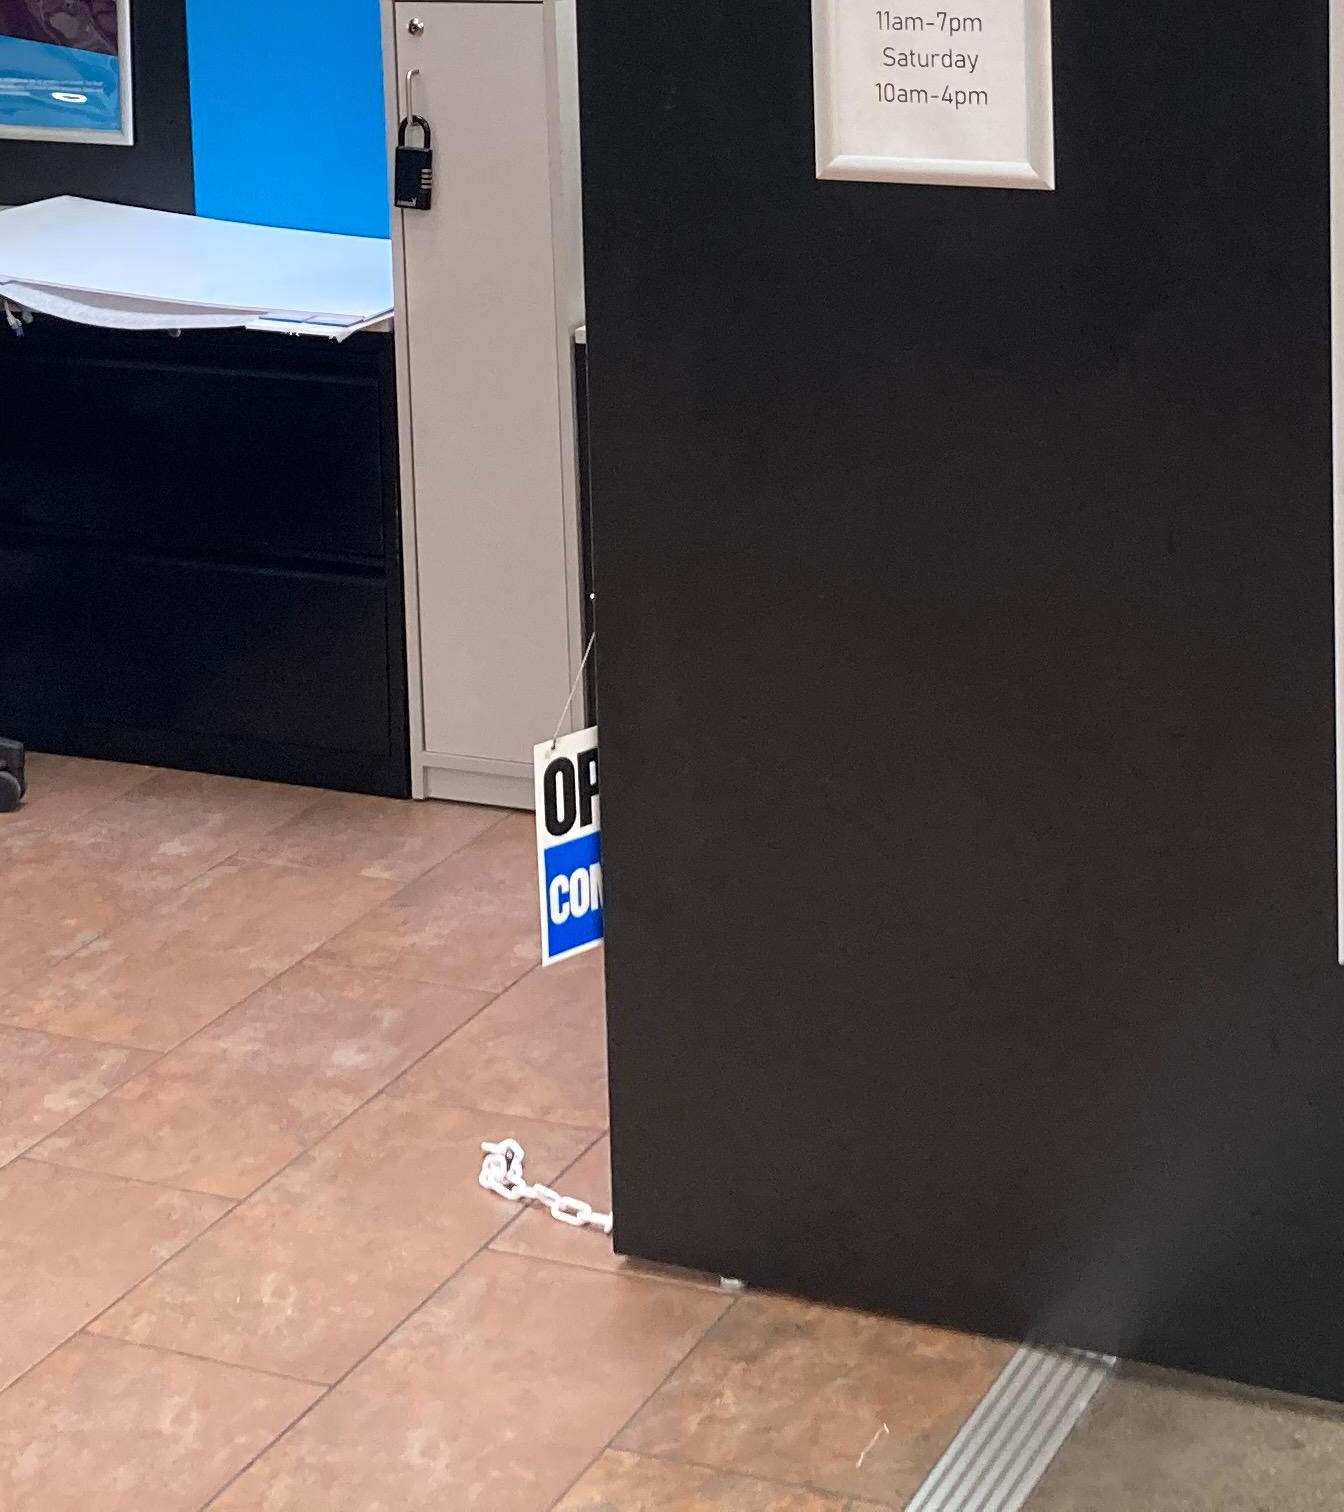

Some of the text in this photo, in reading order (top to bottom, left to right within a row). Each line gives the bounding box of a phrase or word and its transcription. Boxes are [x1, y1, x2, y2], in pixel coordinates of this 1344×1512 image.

[875, 11, 982, 37] 11am-7pm
[882, 46, 979, 73] Saturday
[875, 83, 988, 109] 10am-4pm
[543, 747, 600, 837] OP
[549, 862, 604, 925] CO
